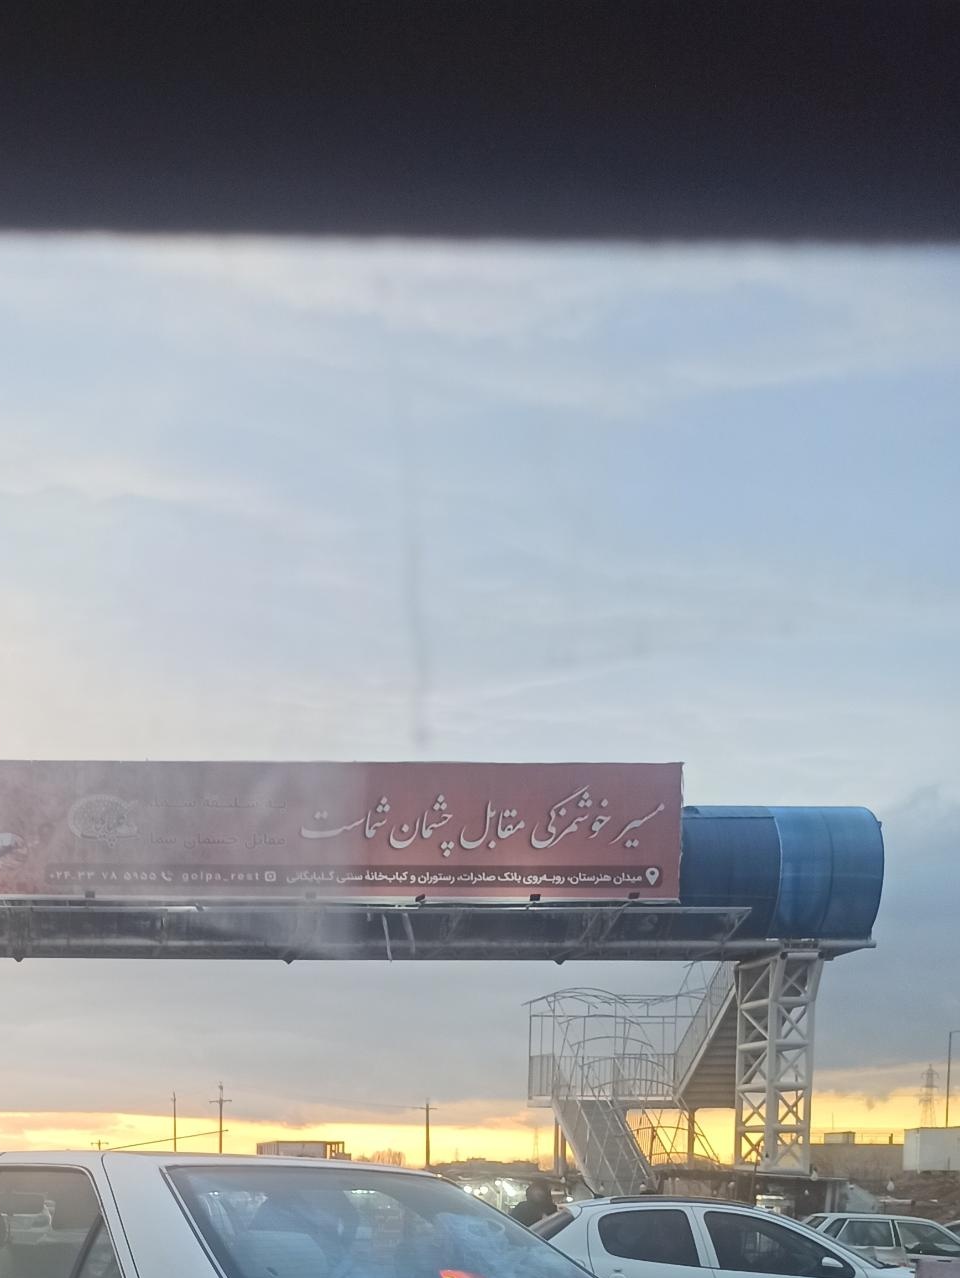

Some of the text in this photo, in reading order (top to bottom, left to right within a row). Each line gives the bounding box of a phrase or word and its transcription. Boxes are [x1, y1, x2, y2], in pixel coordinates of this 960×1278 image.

[300, 785, 665, 858] مسیر خوشمزگی مقابل چشمان شماست
[336, 872, 363, 884] سنتی
[409, 873, 417, 884] و
[417, 871, 456, 884] رستوران
[497, 871, 521, 884] بانک
[612, 872, 643, 885] میدان
